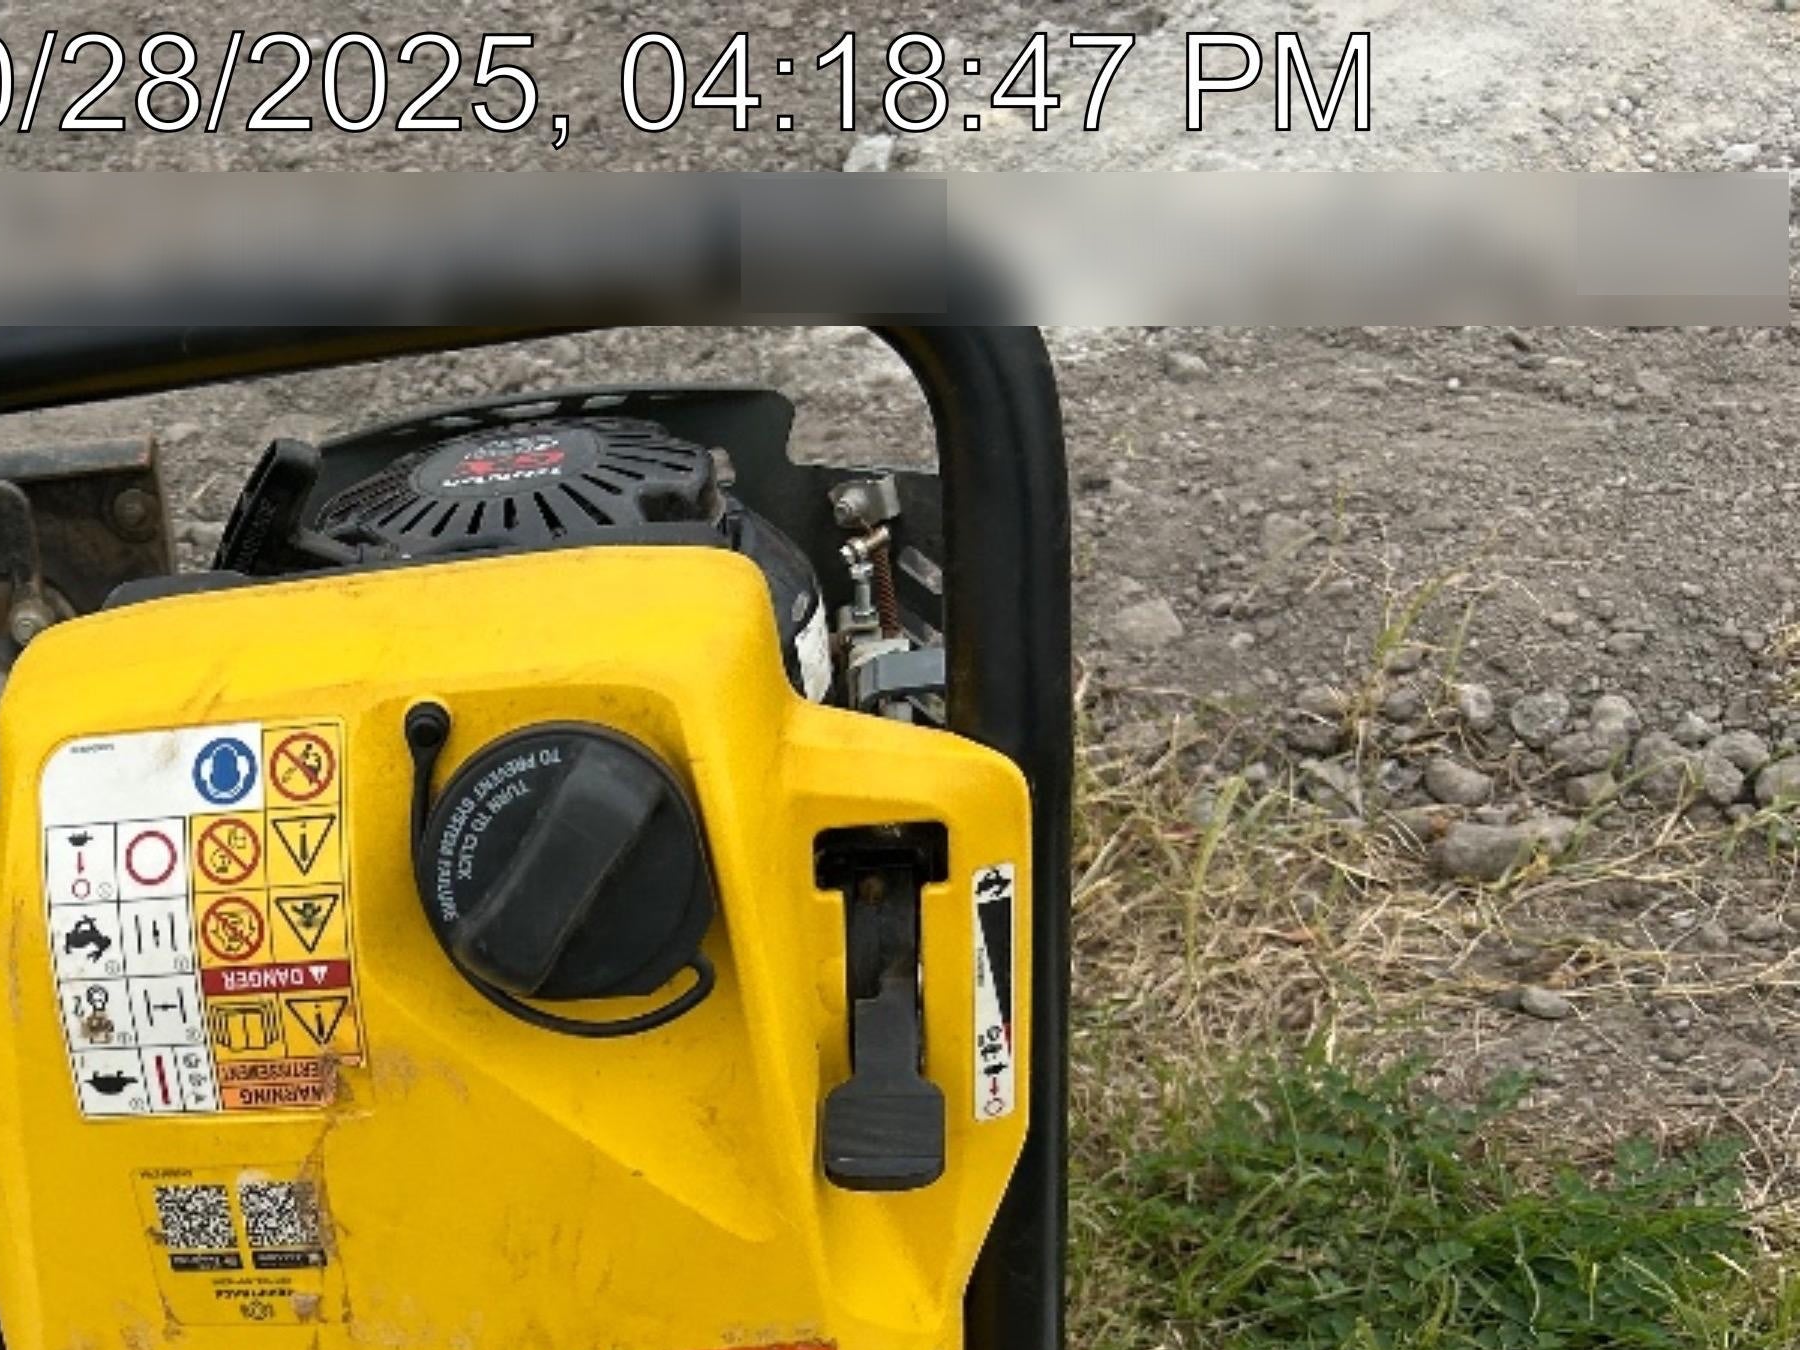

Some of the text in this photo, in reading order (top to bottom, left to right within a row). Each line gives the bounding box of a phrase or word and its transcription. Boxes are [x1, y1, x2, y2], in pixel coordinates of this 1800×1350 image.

[437, 747, 561, 922] TO PREVENT SYSTEM FAILURE
[458, 779, 531, 880] TURN TO CLICK
[222, 968, 304, 990] DANGER
